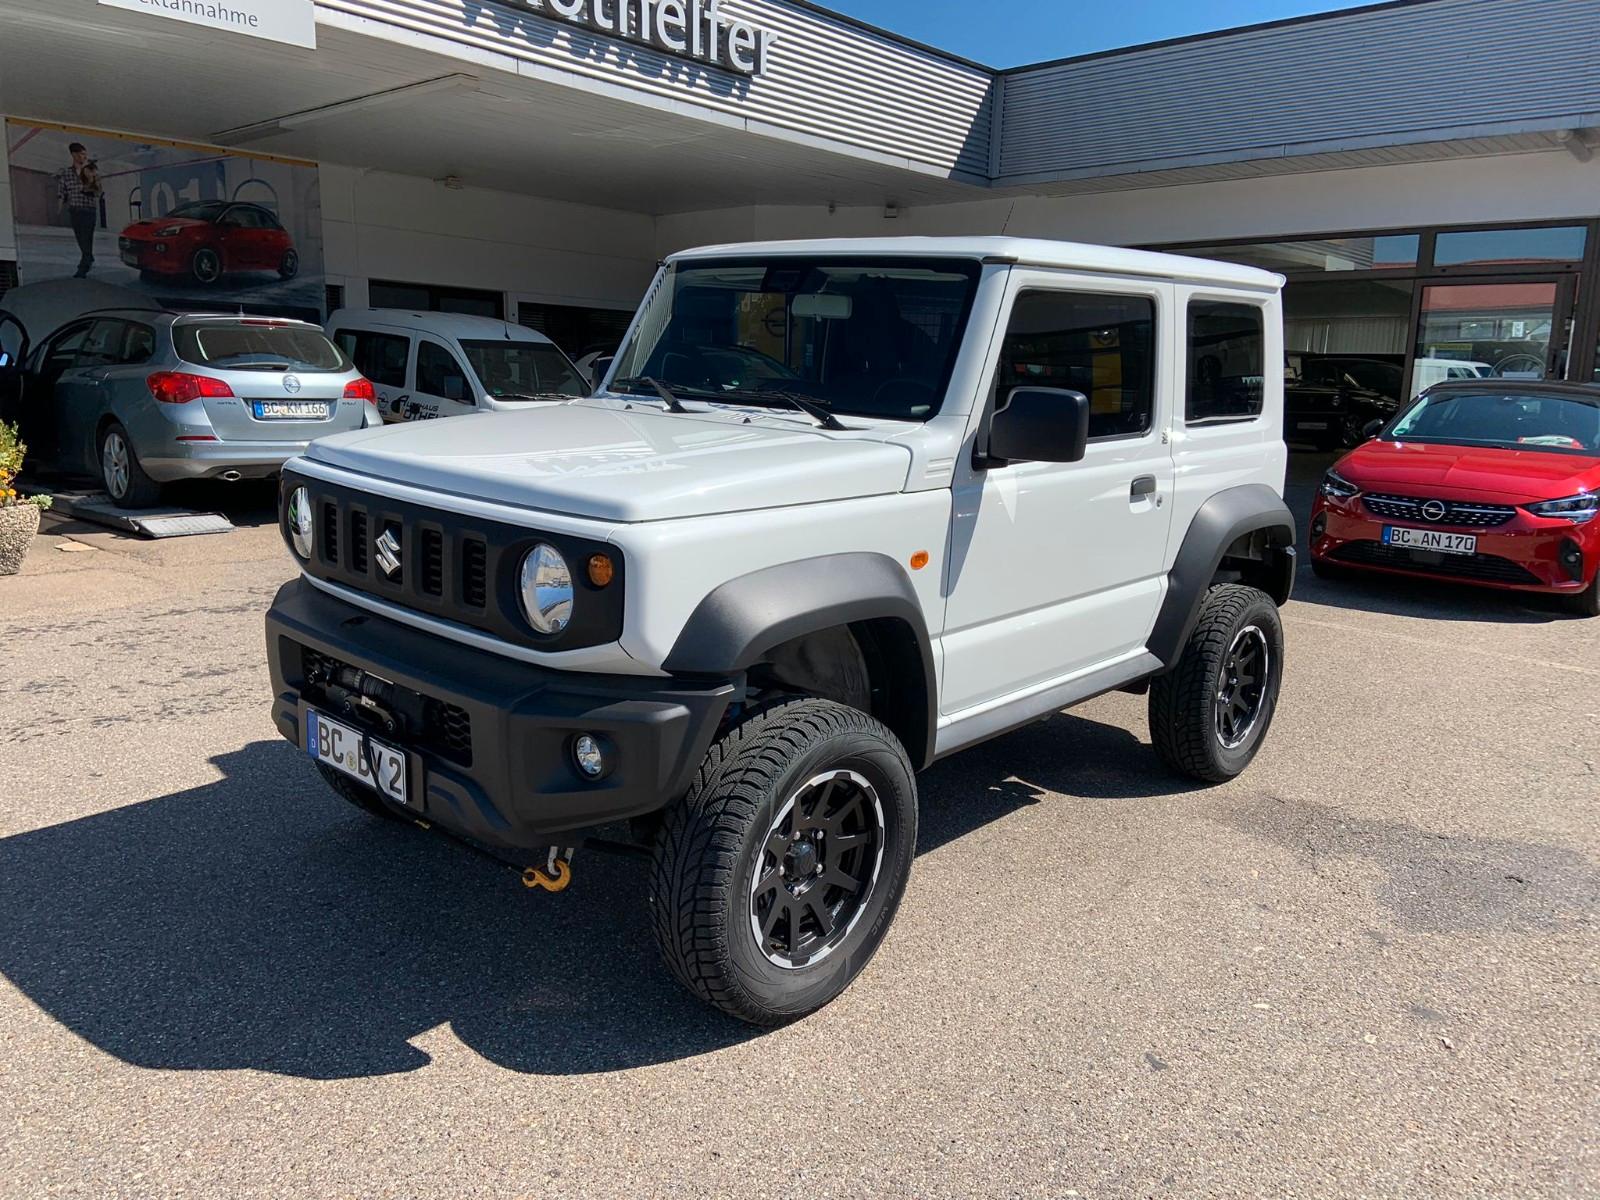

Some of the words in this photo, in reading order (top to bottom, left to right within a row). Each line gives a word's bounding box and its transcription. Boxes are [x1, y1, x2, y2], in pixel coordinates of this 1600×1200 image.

[263, 402, 279, 414] BC
[287, 403, 302, 415] KM
[306, 404, 325, 415] 166
[1391, 529, 1410, 543] BC
[1421, 532, 1441, 547] AN
[1444, 535, 1474, 551] 170
[319, 721, 344, 764] BC
[389, 756, 402, 795] 2
